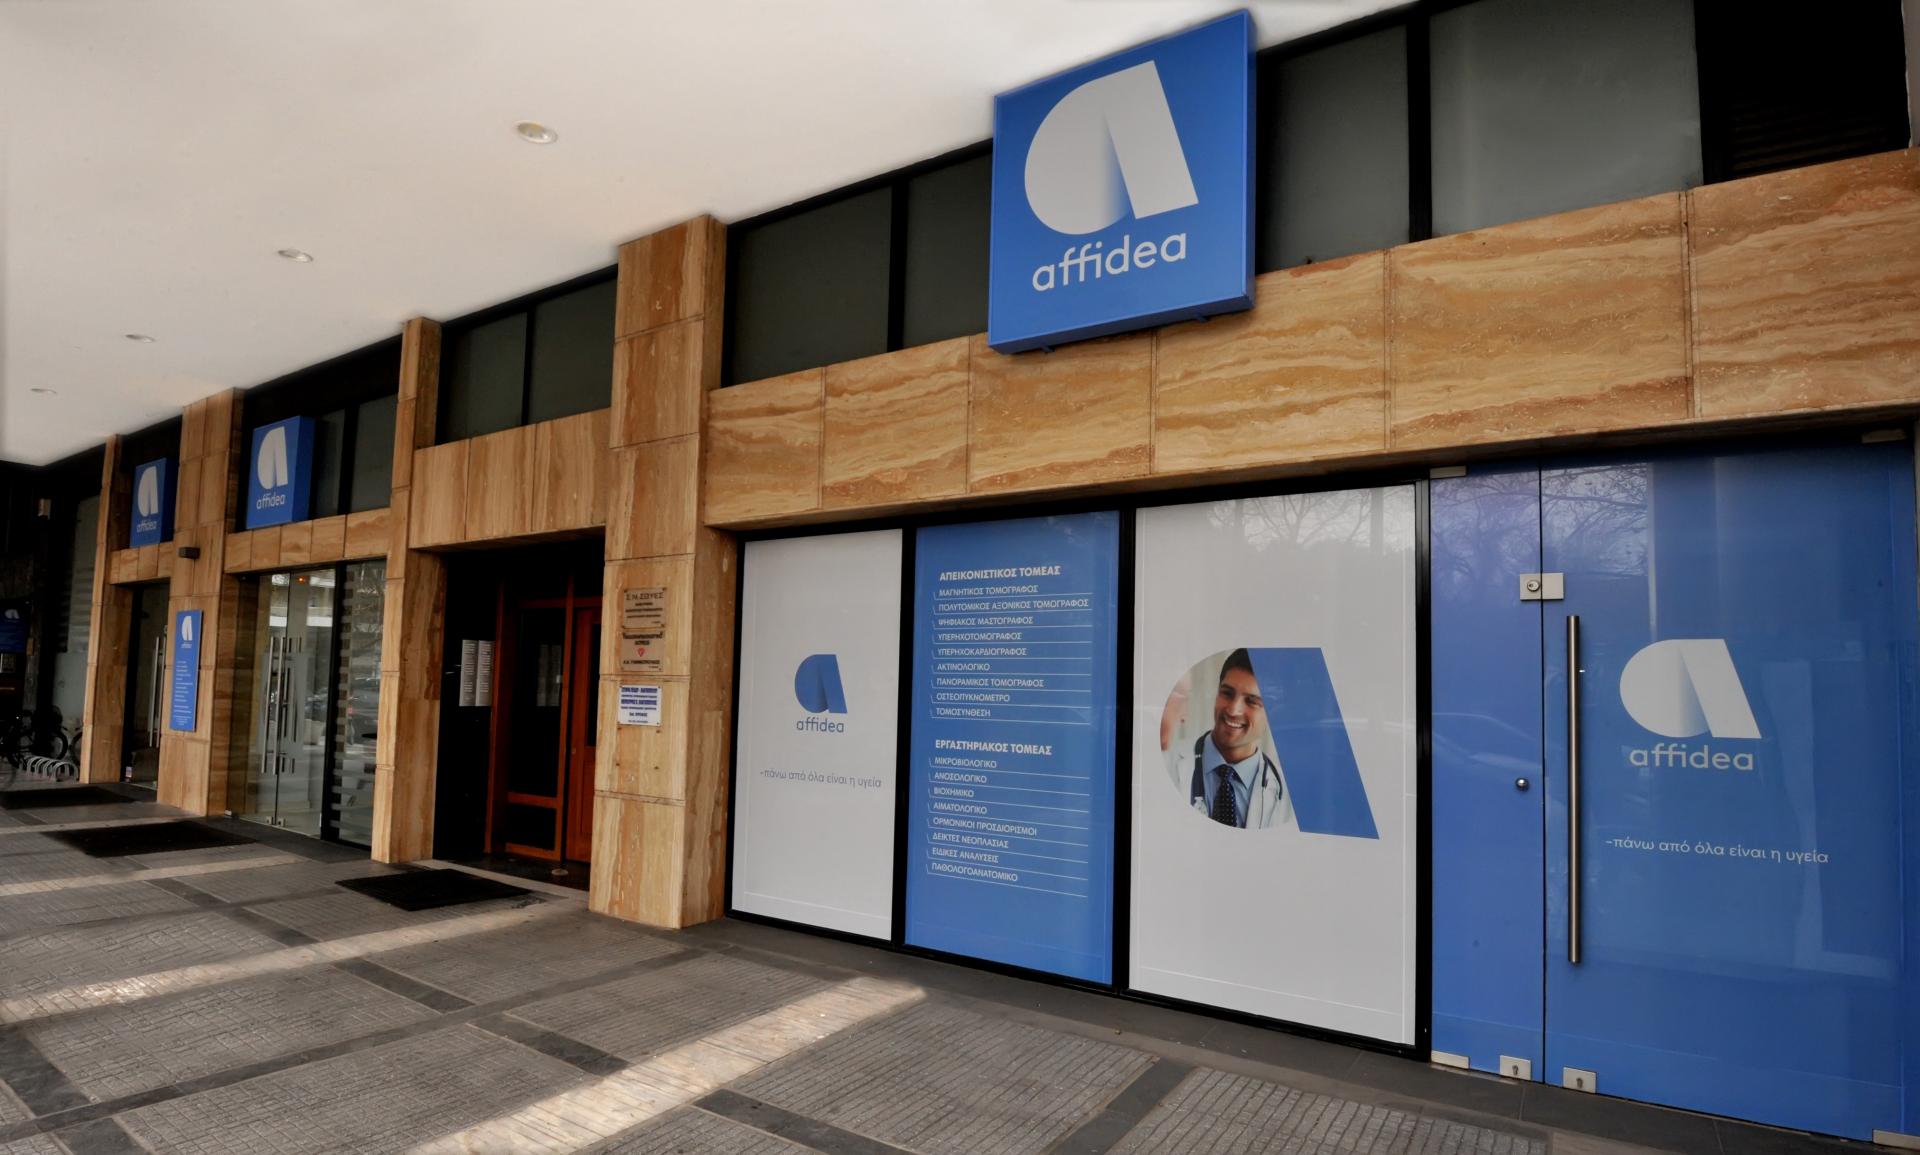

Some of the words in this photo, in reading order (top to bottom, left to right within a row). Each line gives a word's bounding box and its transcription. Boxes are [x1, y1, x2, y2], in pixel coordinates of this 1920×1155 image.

[1032, 233, 1187, 292] affidea
[256, 492, 286, 510] affidea
[939, 567, 1017, 581] ΑΠΕΙΚΟΝΙΣΤΙΚΟΣ
[1019, 565, 1061, 577] ΤΟΜΕΑΣ
[939, 587, 984, 597] ΜΑΓΝΗΤΙΚΟΣ
[985, 585, 1039, 595] ΤΟΜΟΓΡΑΦΟΣ
[938, 602, 990, 612] ΠΟΛΥΤΟΜΙΚΟΣ
[992, 600, 1031, 610] ΑΞΟΝΙΚΟΣ
[1033, 598, 1089, 609] ΤΟΜΟΓΡΑΦΟΣ
[938, 618, 976, 626] ΨΗΦΙΑΚΟΣ
[977, 616, 1034, 626] ΜΑΣΤΟΓΡΑΦΟΣ
[938, 632, 1022, 641] ΥΠΕΡΗΧΟΤΟΜΟΓΡΑΦΟΣ
[938, 647, 1027, 656] ΥΠΕΡΗΧΟΚΑΡΔΙΟΓΡΑΦΟΣ
[937, 663, 991, 671] ΑΚΤΙΝΟΛΟΓΙΚΟ
[936, 677, 989, 687] ΠΑΝΟΡΑΜΙΚΟΣ
[990, 678, 1044, 688] ΤΟΜΟΓΡΑΦΟΣ
[936, 692, 1010, 702] ΟΣΤΕΟΠΥΚΝΟΜΕΤΡΟ
[936, 707, 991, 717] ΤΟΜΟΣΥΝΘΕΣΗ
[796, 717, 845, 733] affidea
[935, 739, 1009, 753] ΕΡΓΑΣΤΗΡΙΑΚΟΣ
[1010, 743, 1053, 756] ΤΟΜΕΑΣ
[934, 757, 997, 768] ΜΙΚΡΟΒΙΟΛΟΓΙΚΟ
[1629, 742, 1754, 771] affidea
[788, 770, 806, 781] από
[807, 771, 825, 782] όλα
[827, 773, 847, 785] είναι
[849, 776, 856, 788] η
[857, 776, 882, 789] υγεία
[934, 772, 987, 783] ΑΝΟΣΟΛΟΓΙΚΟ
[933, 787, 975, 798] ΒΙΟΧΗΜΙΚΟ
[933, 802, 988, 815] ΑΙΜΑΤΟΛΟΓΙΚΟ
[933, 817, 975, 828] ΟΡΜΟΝΙΚΟΙ
[976, 822, 1037, 836] ΠΡΟΣΔΙΟΡΙΣΜΟΙ
[932, 832, 960, 842] ΔΕΙΚΤΕΣ
[961, 835, 1009, 849] ΝΕΟΠΛΑΣΙΑΣ
[932, 847, 958, 857] ΕΙΔΙΚΕΣ
[959, 851, 999, 863] ΑΝΑΛΥΣΕΙΣ
[1605, 836, 1655, 850] -πάνω
[1659, 839, 1690, 853] από
[1695, 842, 1724, 855] όλα
[1729, 843, 1766, 859] είναι
[1770, 849, 1781, 863] η
[1785, 849, 1829, 865] υγεία
[931, 863, 1018, 882] ΠΑΘΟΛΟΓΟΑΝΑΤΟΜΙΚΟ
